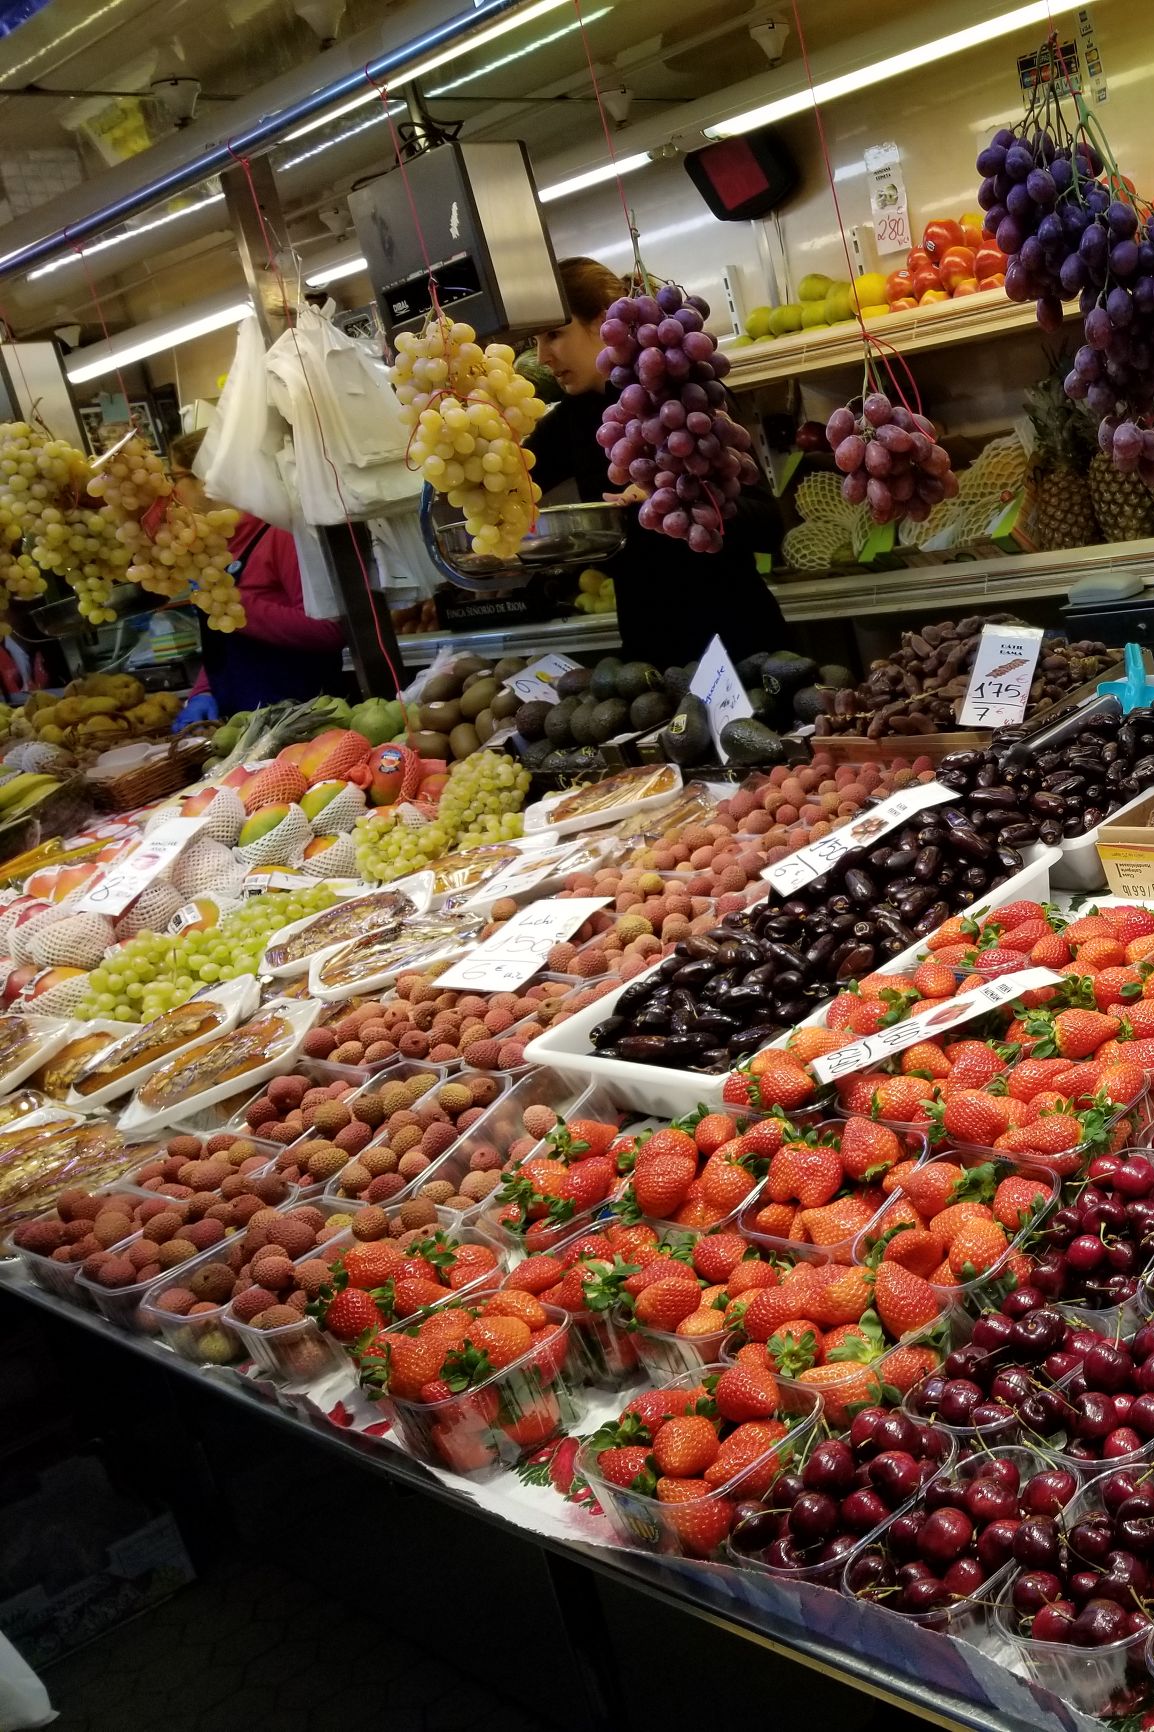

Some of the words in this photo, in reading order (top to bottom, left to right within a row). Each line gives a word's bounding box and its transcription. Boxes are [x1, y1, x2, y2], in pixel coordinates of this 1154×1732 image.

[972, 681, 1021, 698] 1'75
[1122, 885, 1132, 896] lb
[1132, 885, 1146, 897] 6.6
[462, 963, 491, 979] 6
